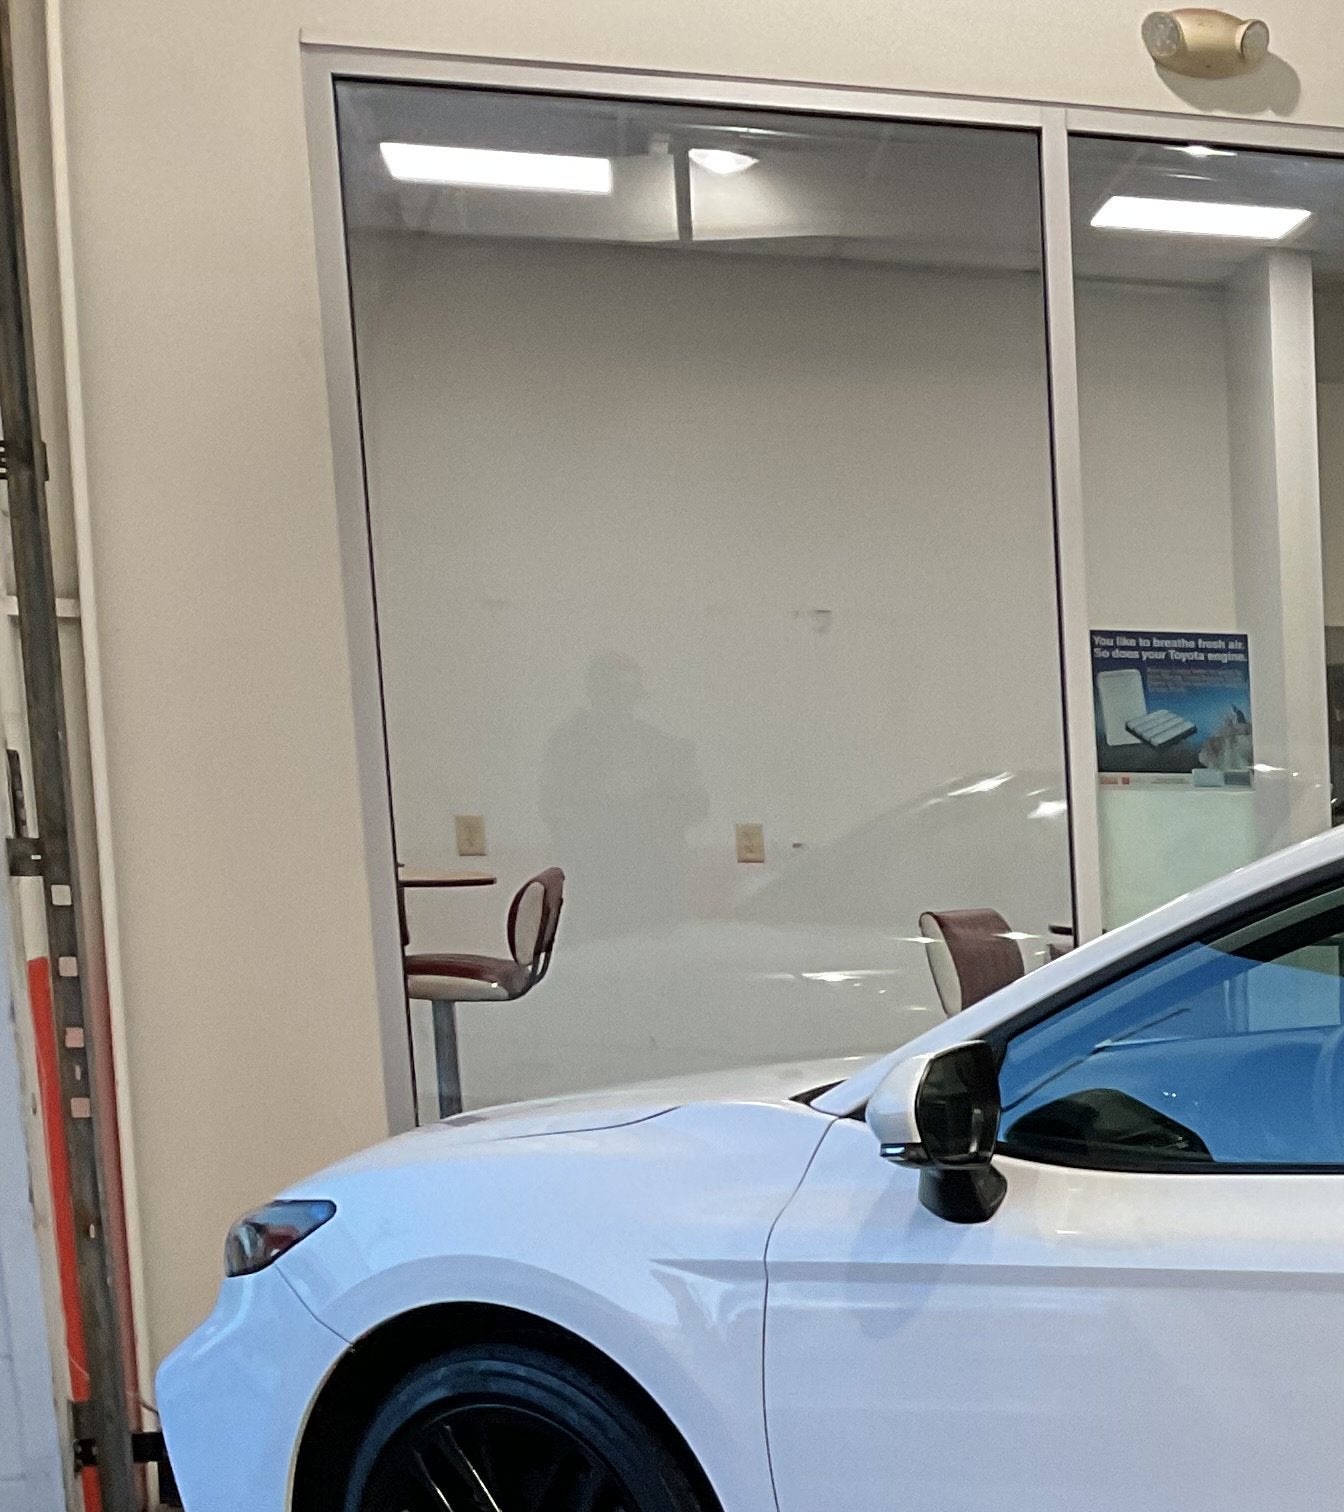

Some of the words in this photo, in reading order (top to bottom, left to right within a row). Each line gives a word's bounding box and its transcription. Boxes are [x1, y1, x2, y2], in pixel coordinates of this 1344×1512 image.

[1093, 635, 1114, 647] You
[1116, 636, 1136, 647] like
[1139, 637, 1150, 648] to
[1153, 637, 1195, 649] breathe
[1198, 638, 1226, 650] fresh
[1094, 647, 1109, 658] So
[1112, 648, 1139, 659] does
[1141, 650, 1167, 661] your
[1169, 649, 1205, 662] Toyota
